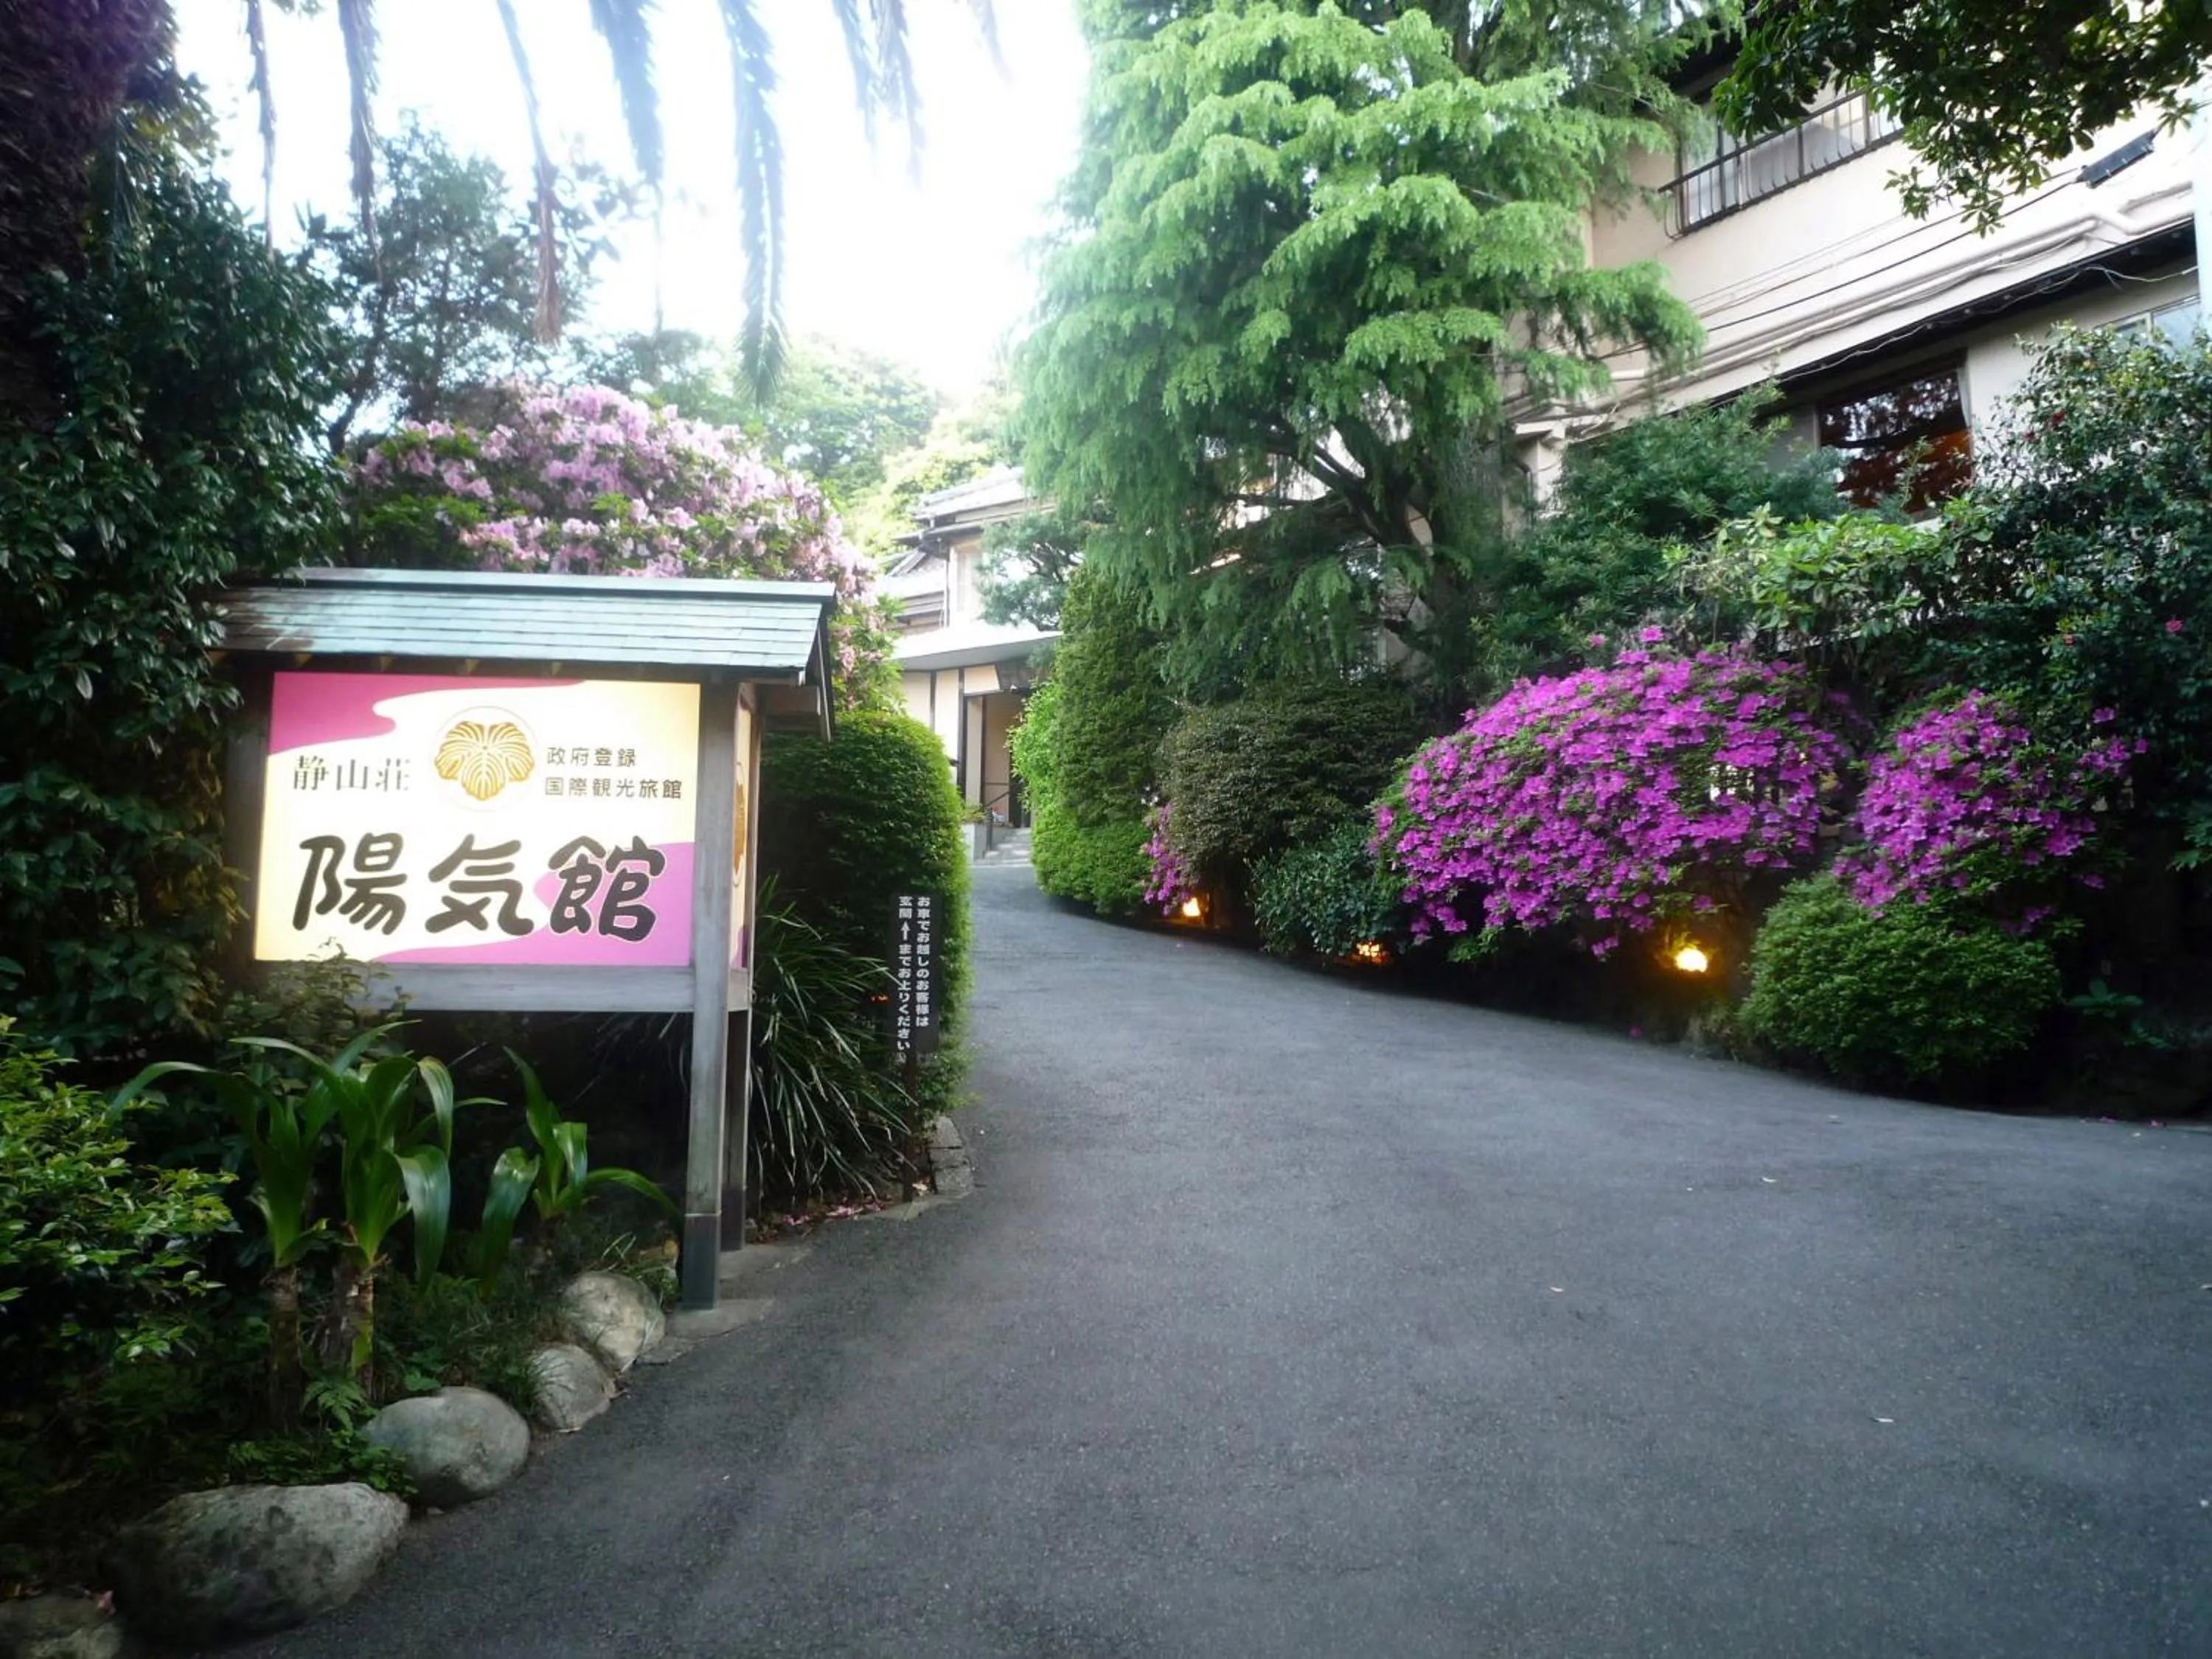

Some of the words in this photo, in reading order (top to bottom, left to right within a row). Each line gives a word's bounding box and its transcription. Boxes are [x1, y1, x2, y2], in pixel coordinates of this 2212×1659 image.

[546, 747, 636, 768] 政府登録
[293, 755, 410, 793] 静山荘
[545, 776, 682, 799] 国際観光旅館
[293, 832, 665, 942] 陽気館
